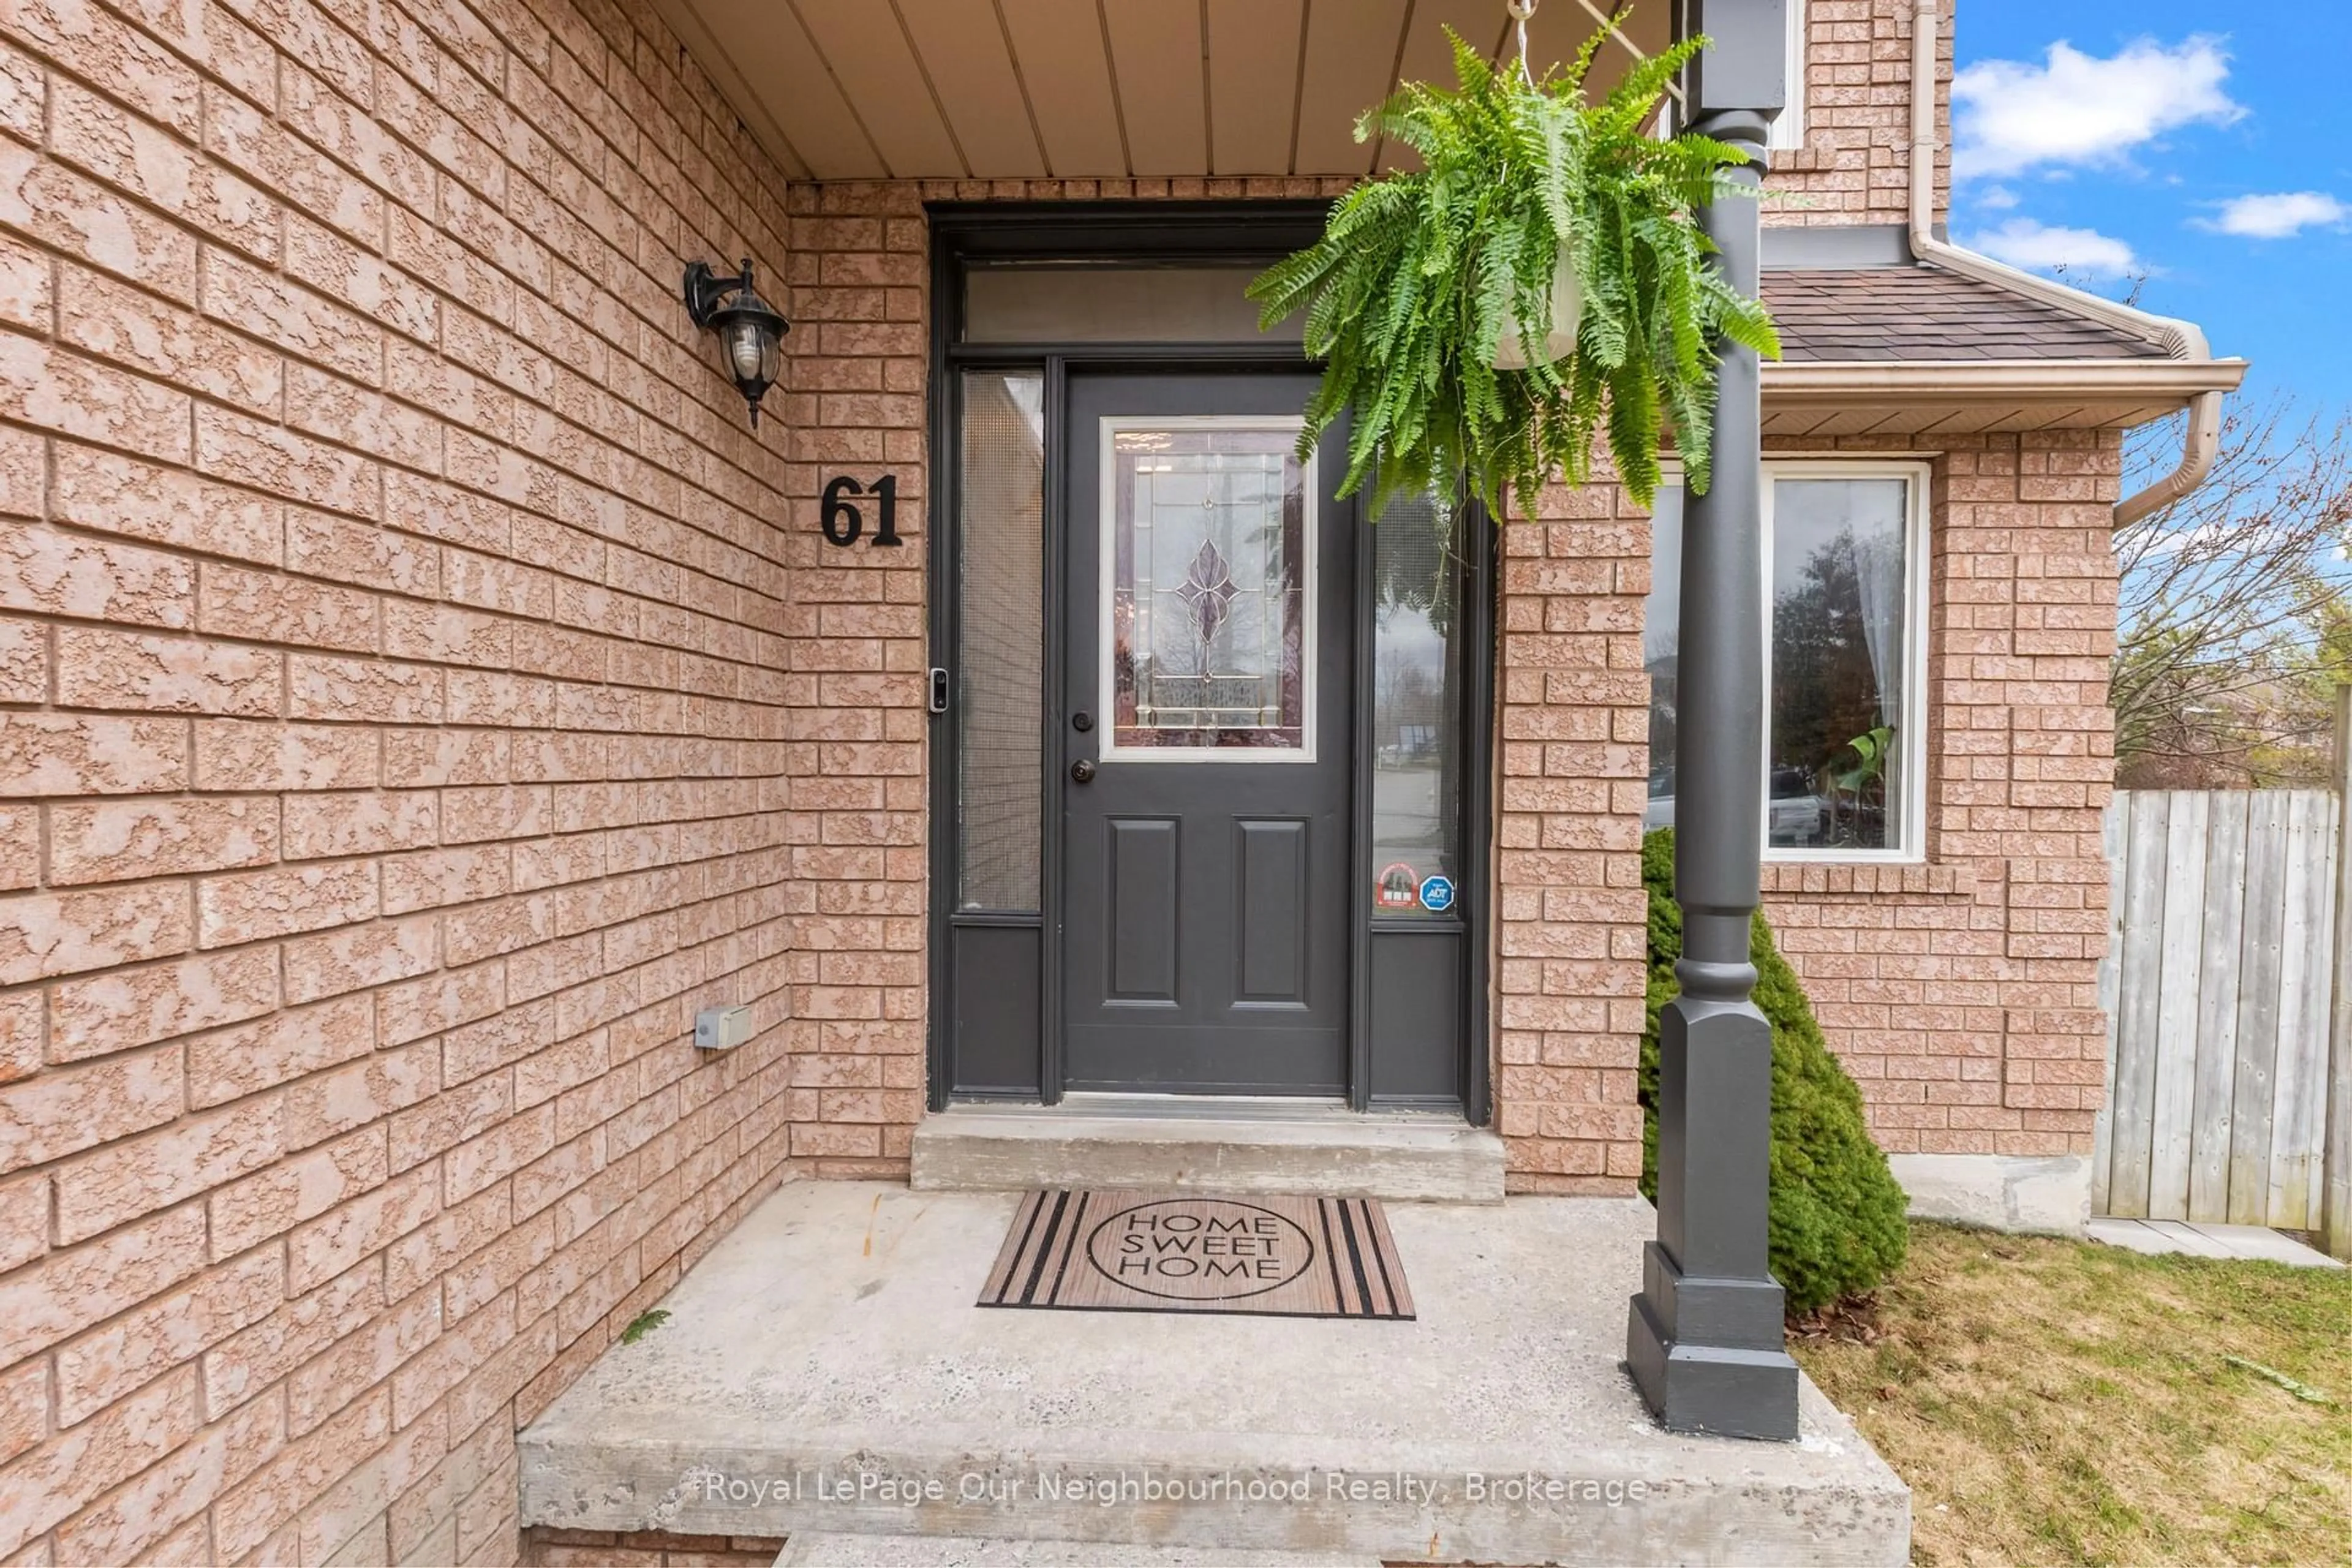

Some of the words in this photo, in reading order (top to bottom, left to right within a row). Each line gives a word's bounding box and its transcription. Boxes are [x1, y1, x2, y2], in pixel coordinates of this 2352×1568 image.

[821, 475, 902, 546] 61
[1427, 888, 1447, 899] ADT
[1128, 1214, 1278, 1235] HOME
[1120, 1235, 1280, 1256] SWEET
[1118, 1256, 1281, 1280] HOME
